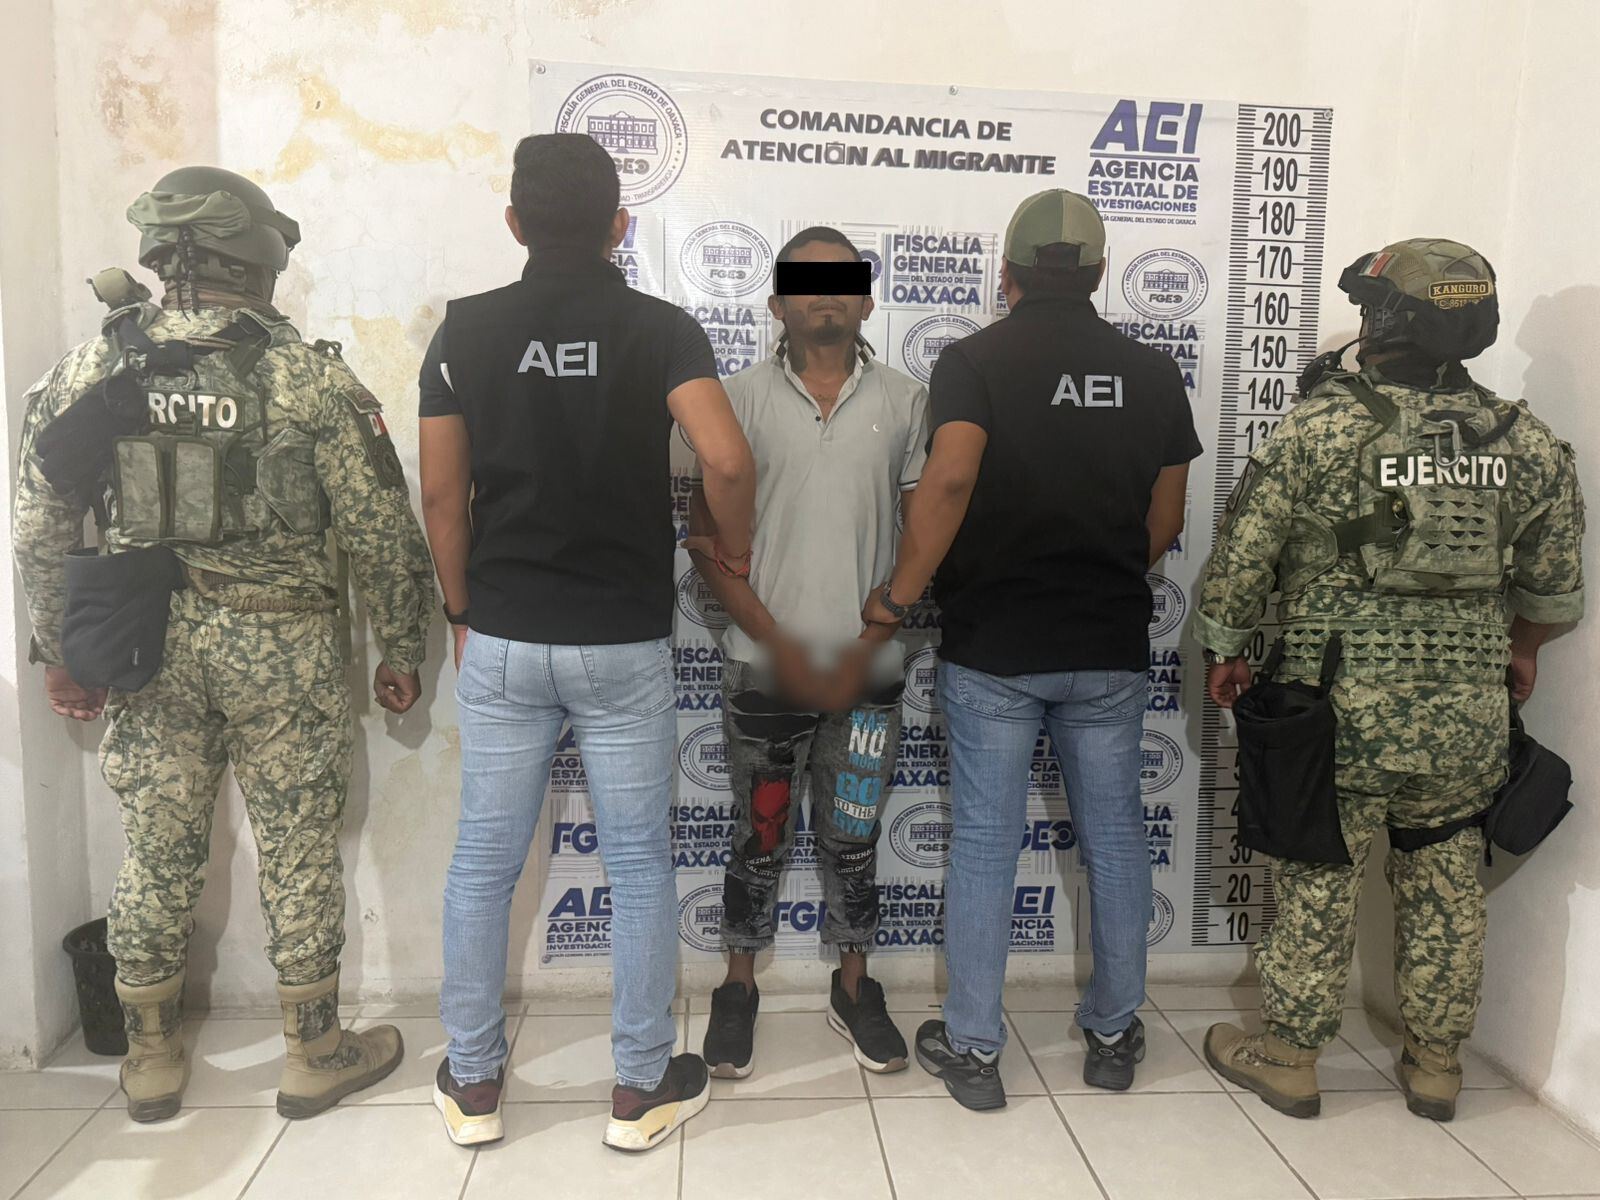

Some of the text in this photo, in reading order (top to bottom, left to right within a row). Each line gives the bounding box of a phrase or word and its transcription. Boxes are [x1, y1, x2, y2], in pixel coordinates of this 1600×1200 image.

[559, 79, 683, 139] FISCALÍA GENERAL DEL ESTADO DE OAXACA
[760, 108, 1013, 142] COMANDANCIA DE
[1090, 99, 1203, 154] AEI
[1263, 112, 1301, 147] 200
[612, 157, 650, 175] GEO
[871, 147, 910, 168] AL
[914, 149, 1057, 176] MIGRANTE
[1088, 159, 1199, 182] AGENCIA
[1261, 156, 1298, 192] 190
[1088, 180, 1199, 200] ESTATAL DE
[1259, 200, 1295, 236] 180
[893, 234, 984, 255] FISCALÍA
[893, 255, 983, 275] GENERAL
[1257, 244, 1293, 280] 170
[911, 275, 964, 284] DEL ESTADO DE
[892, 285, 981, 306] OAXACA
[1432, 284, 1486, 296] KANGURO
[684, 306, 756, 326] SCALÍA
[1254, 291, 1290, 326] 160
[706, 327, 757, 346] ERAL
[517, 340, 598, 377] AEI
[1250, 334, 1287, 368] 150
[715, 357, 752, 376] ACA
[1050, 373, 1123, 408] AEI
[1247, 377, 1284, 411] 140
[148, 392, 237, 428] RCITO
[1244, 420, 1279, 452] 13
[673, 647, 725, 664] ISCA
[676, 693, 722, 711] AXA
[921, 688, 936, 697] FG
[899, 725, 946, 742] SCAL
[897, 744, 949, 759] ENERA
[911, 760, 937, 768] ESTADO
[551, 769, 588, 779] ESTA
[889, 769, 950, 787] AXAC
[1041, 773, 1060, 782] DE
[670, 805, 740, 822] ISCALÍ
[852, 805, 876, 818] THE
[551, 822, 599, 854] FG
[671, 823, 735, 840] ENERA
[694, 841, 721, 849] ESTADO
[721, 840, 731, 848] DE
[1229, 834, 1252, 864] 30
[672, 850, 732, 868] AXAC
[876, 884, 944, 901] FISCAL
[1226, 873, 1251, 903] 20
[547, 886, 613, 918] AE
[1013, 885, 1056, 915] EI
[773, 901, 827, 932] FG
[878, 902, 944, 918] GENERA
[547, 921, 611, 934] AGENC
[906, 919, 932, 927] ESTADO
[1012, 919, 1054, 929] NCIA
[1226, 912, 1249, 941] 10
[547, 933, 611, 943] ESTATAL
[874, 928, 944, 947] OAXAC
[1036, 930, 1054, 939] DE
[547, 942, 611, 951] INVESTIGACI
